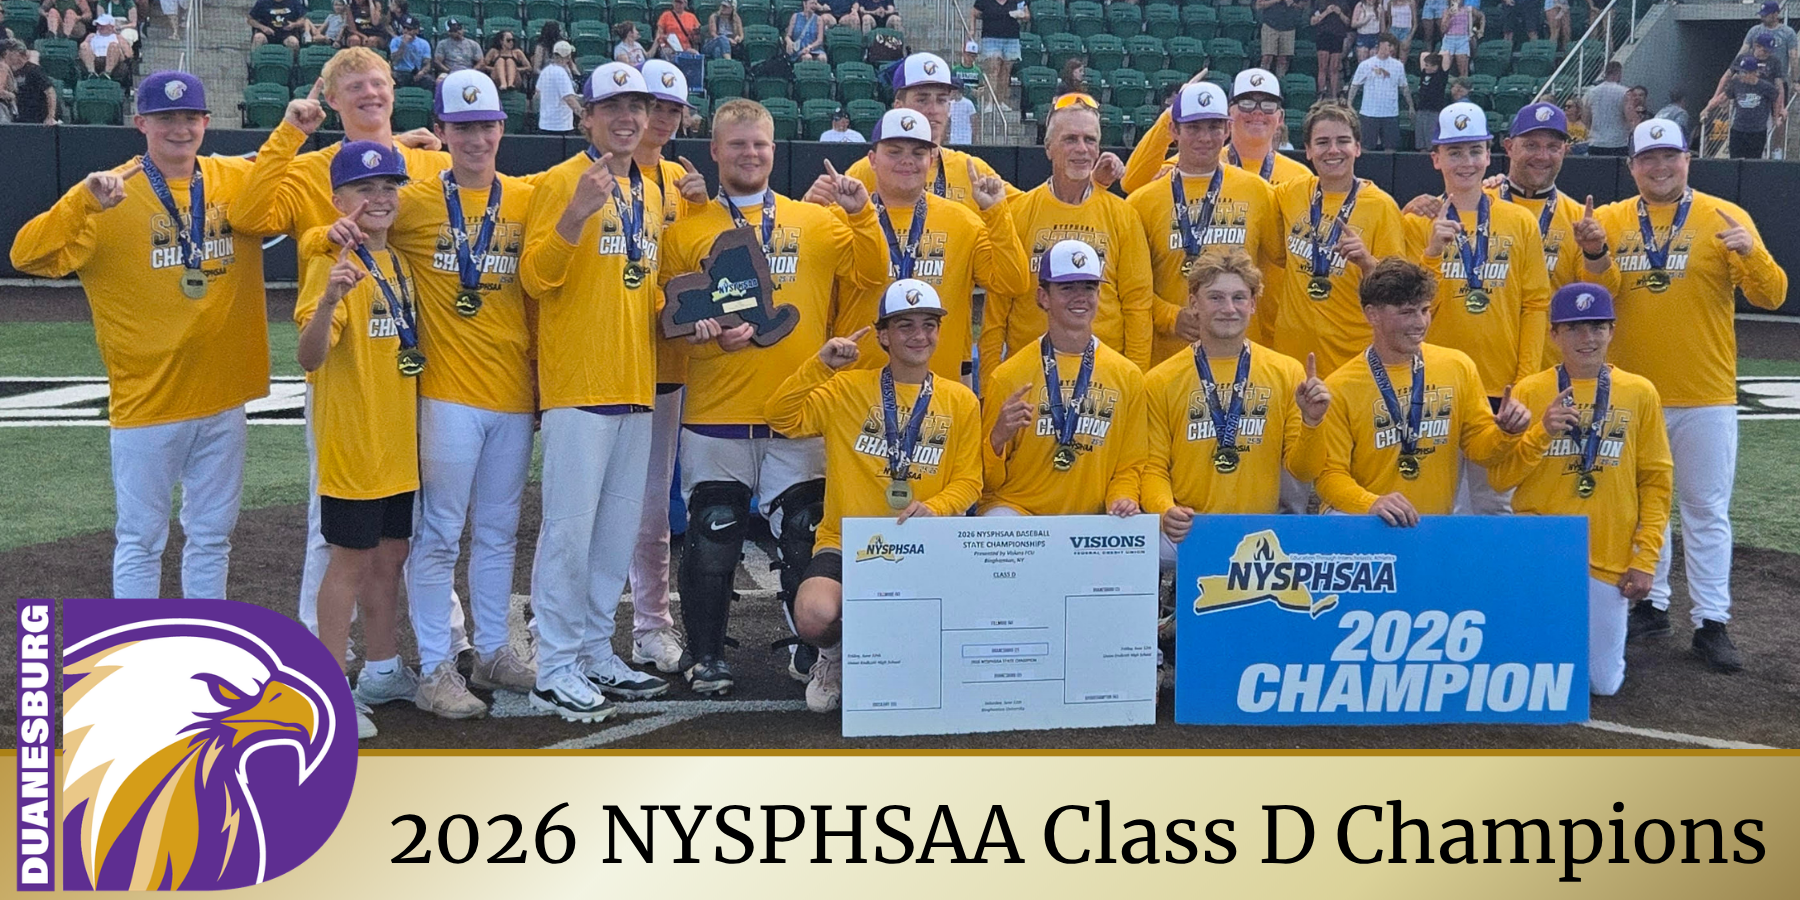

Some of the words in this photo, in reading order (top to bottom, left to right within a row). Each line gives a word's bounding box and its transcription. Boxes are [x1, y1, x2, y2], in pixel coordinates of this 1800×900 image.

[866, 543, 925, 555] NYSPHSAA
[963, 541, 984, 549] STATE
[986, 540, 1046, 548] CHAMPIONSHIPS
[1069, 535, 1146, 549] VISIONS
[1227, 561, 1397, 592] NYSPHSAA
[1330, 609, 1486, 663] 2026
[1236, 662, 1574, 713] CHAMPION
